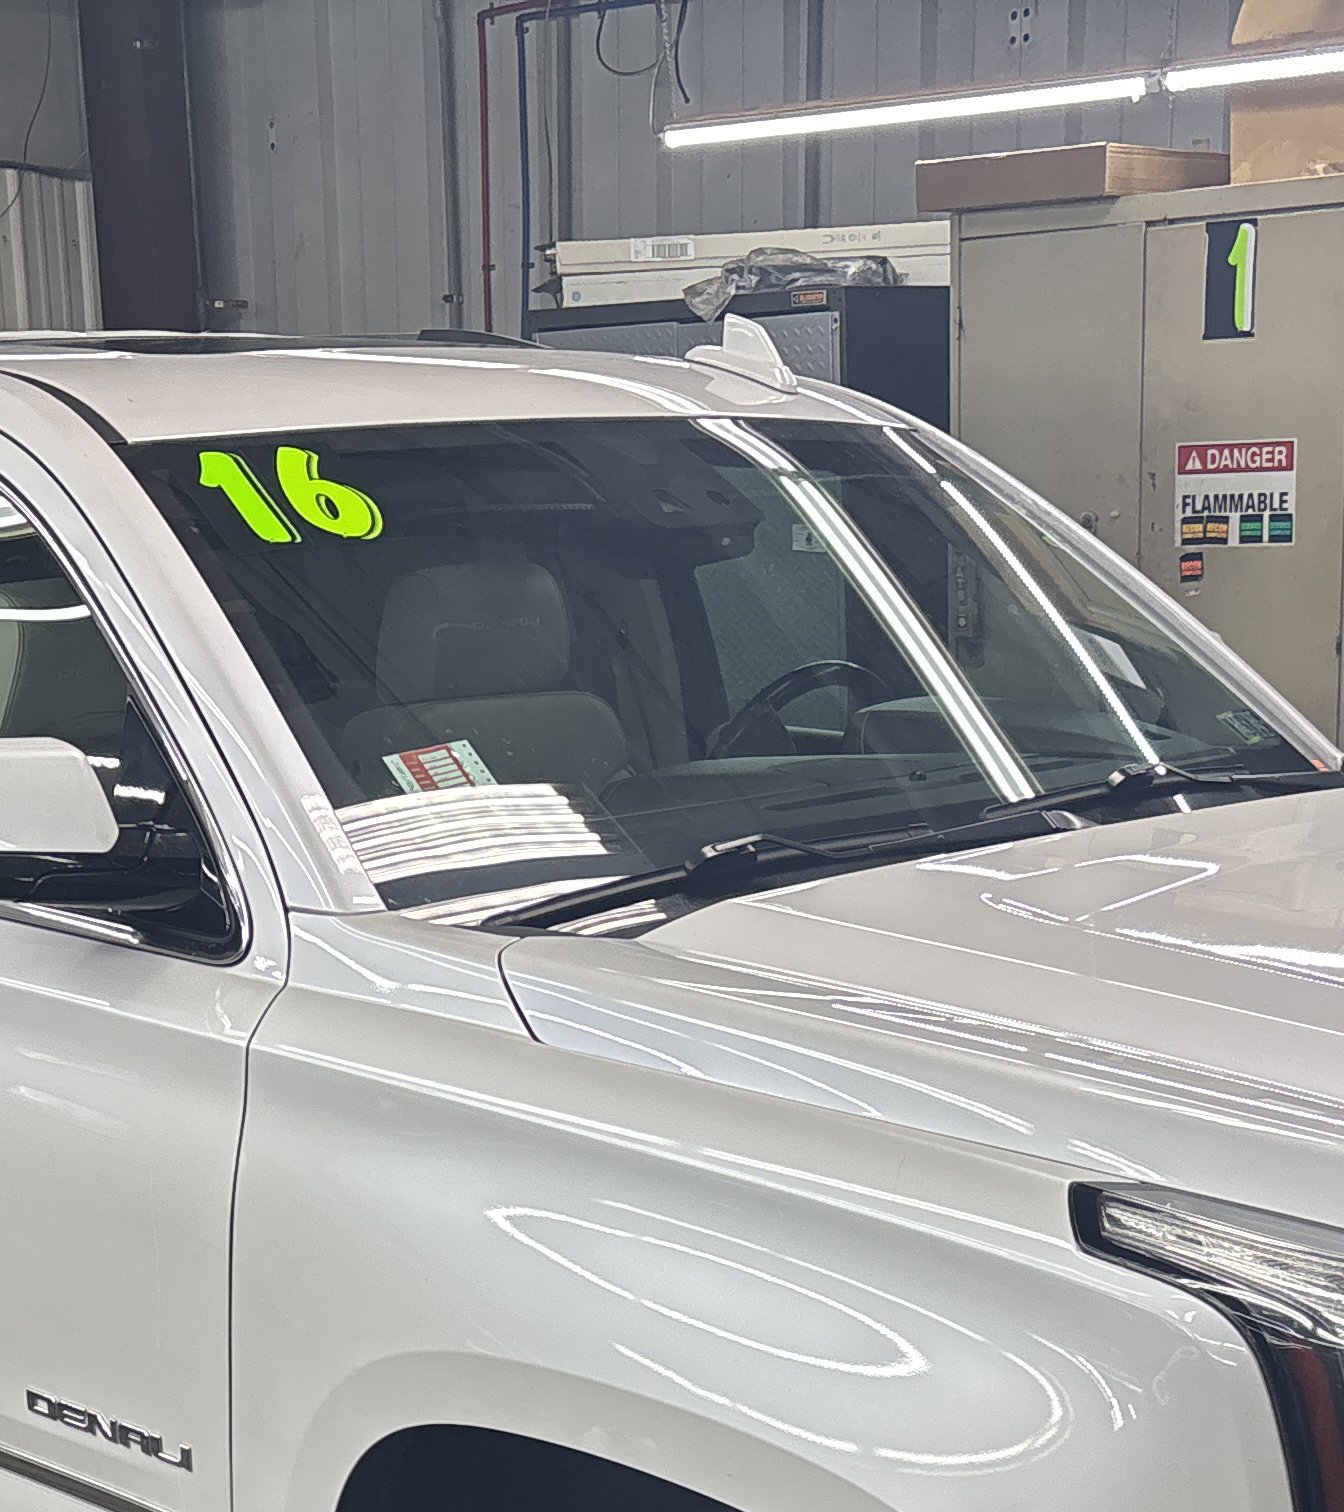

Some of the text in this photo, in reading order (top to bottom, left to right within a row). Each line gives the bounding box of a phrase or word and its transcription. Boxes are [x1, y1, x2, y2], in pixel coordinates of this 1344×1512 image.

[1227, 222, 1256, 332] 1
[198, 445, 385, 544] 16
[1206, 446, 1287, 470] DANGER
[1181, 491, 1289, 515] FLAMMABLE
[24, 1386, 194, 1473] DENALI
